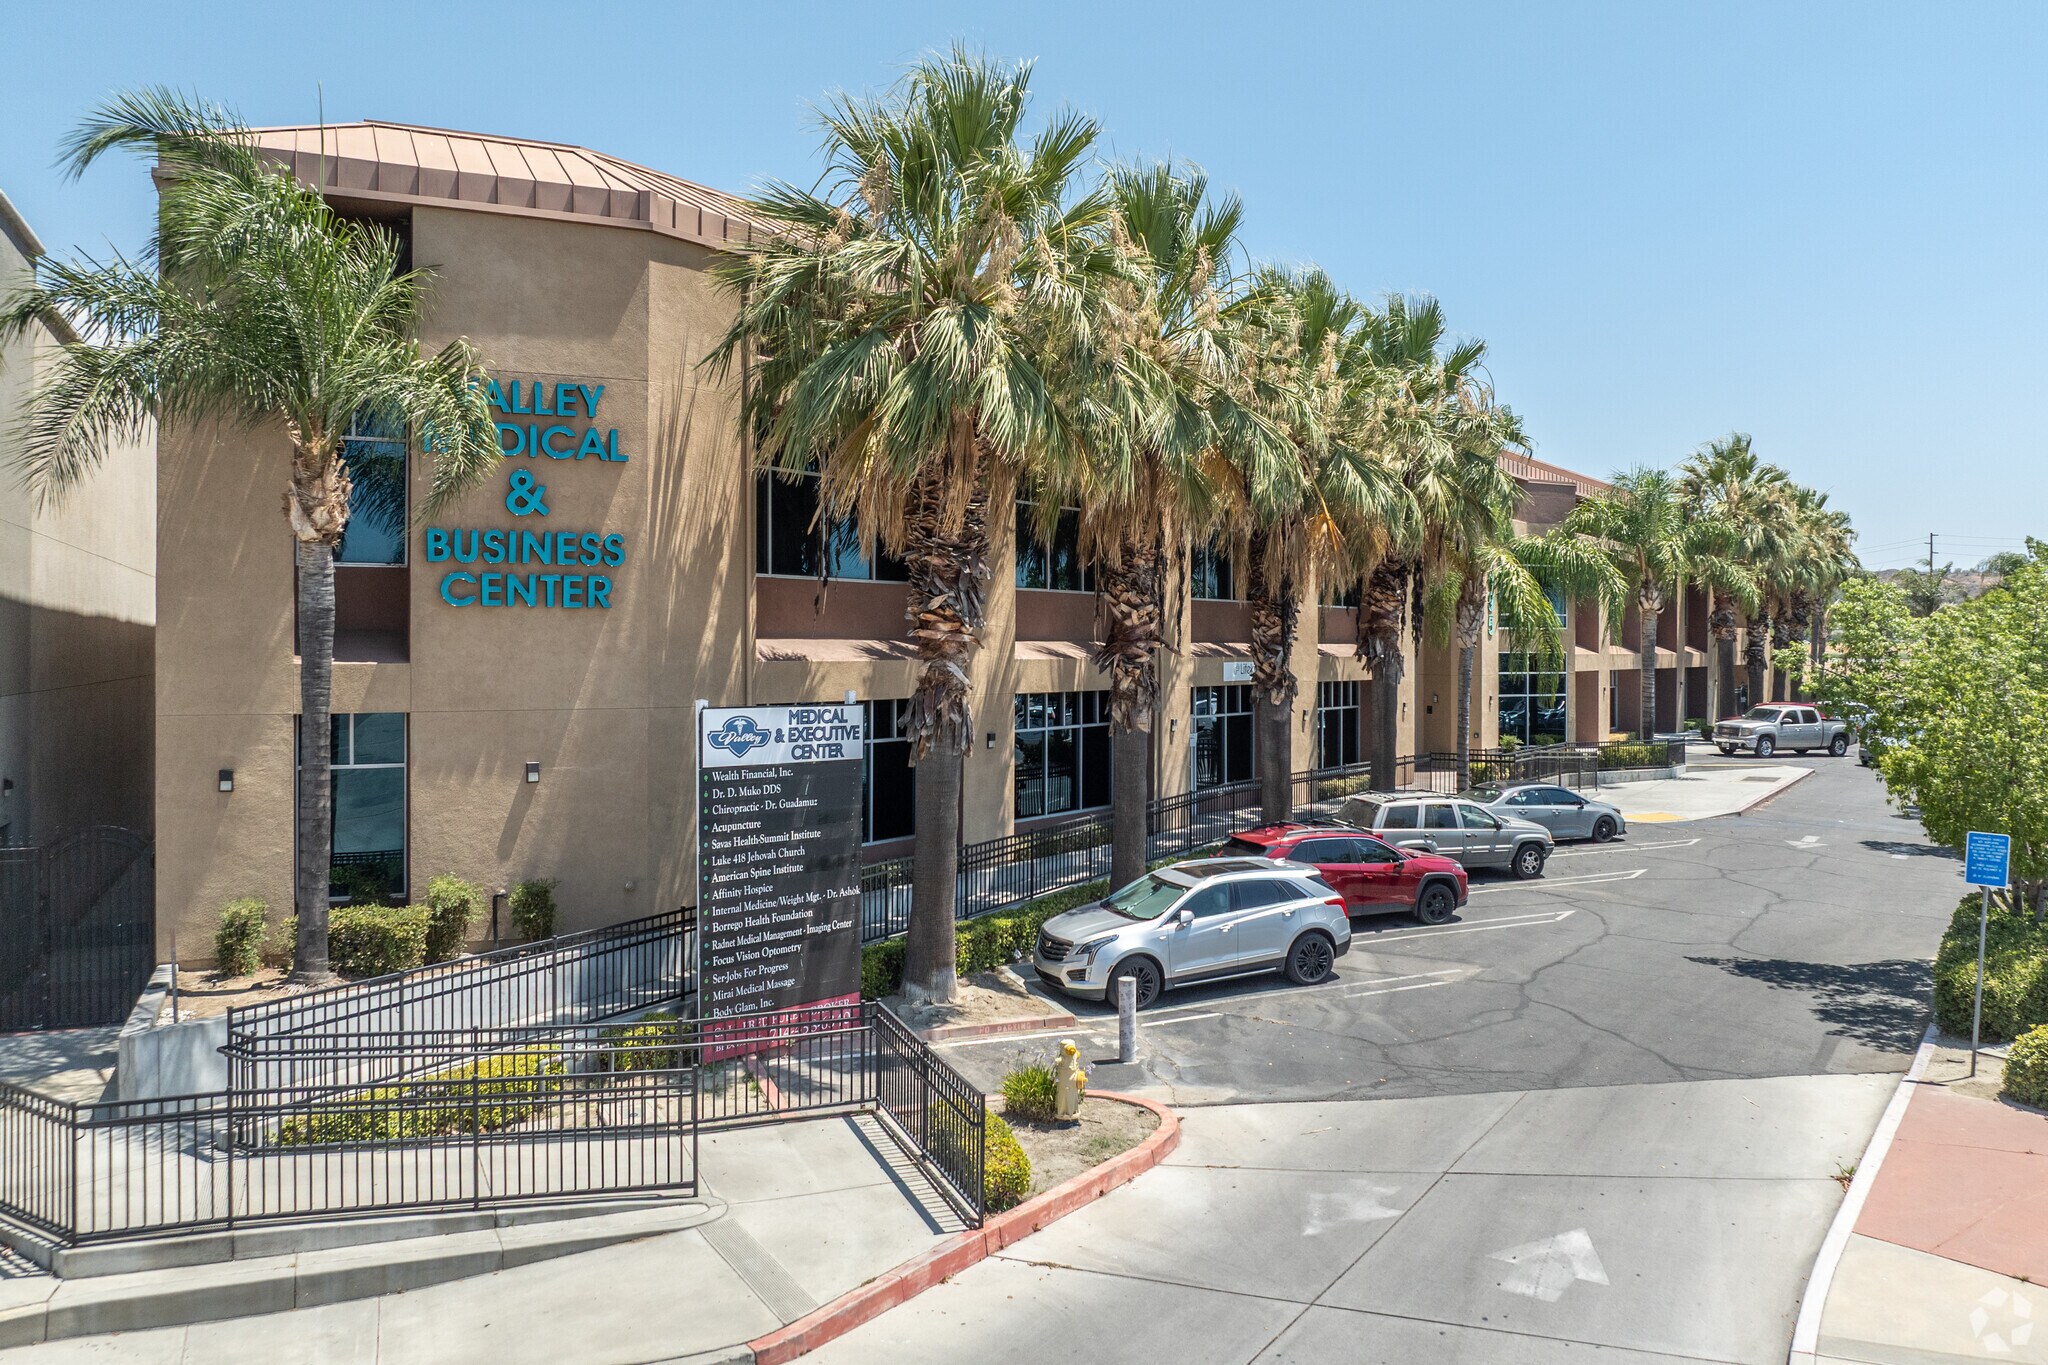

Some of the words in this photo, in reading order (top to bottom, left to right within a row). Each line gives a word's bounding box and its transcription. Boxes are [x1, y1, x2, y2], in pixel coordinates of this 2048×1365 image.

[468, 377, 604, 418] ALLEY
[423, 422, 629, 463] DICAL
[506, 469, 551, 516] &
[427, 528, 626, 567] BUSINESS
[441, 572, 612, 608] CENTER
[789, 709, 848, 724] MEDICAL
[719, 733, 763, 744] Valley
[774, 728, 785, 743] &
[789, 726, 860, 742] EXECUTIVE
[791, 744, 844, 759] CENTER
[712, 771, 739, 781] Wealth
[742, 769, 778, 779] Financial,
[779, 768, 793, 776] Inc.
[713, 790, 725, 798] Dr.
[728, 788, 737, 797] D.
[739, 787, 761, 797] Muko
[763, 785, 781, 794] DDS
[712, 803, 759, 815] Chiropractic
[765, 801, 777, 810] Dr.
[779, 798, 817, 809] Guadamuz
[712, 820, 761, 833] Acupuncture
[712, 840, 732, 849] Savas
[792, 830, 821, 840] Institute
[712, 856, 731, 866] Luke
[733, 854, 746, 863] 418
[748, 851, 776, 863] Jehovah
[778, 847, 805, 857] Church
[712, 872, 748, 883] American
[751, 868, 771, 880] Spine
[773, 864, 803, 874] Institute
[712, 889, 742, 900] Affinity
[744, 884, 773, 896] Hospice
[712, 904, 742, 916] Internal
[744, 895, 804, 912] Medicine/Weight
[806, 892, 821, 904] Mgt.
[827, 890, 838, 900] Dr.
[840, 885, 860, 897] Ashok
[712, 920, 742, 932] Borrego
[745, 916, 770, 927] Health
[772, 910, 813, 923] Foundation
[712, 940, 735, 950] Radnet
[737, 934, 762, 946] Medical
[764, 927, 802, 942] Management
[807, 923, 831, 934] Imaging
[832, 920, 852, 929] Center
[713, 956, 734, 966] Focus
[736, 951, 759, 961] Vision
[762, 943, 802, 957] Optometry
[744, 968, 756, 976] For
[759, 962, 788, 975] Progress
[713, 991, 733, 1002] Mirai
[736, 984, 764, 996] Medical
[766, 977, 795, 989] Massage
[713, 1007, 734, 1018] Body
[735, 1000, 758, 1014] Glam,
[760, 999, 774, 1007] Inc.
